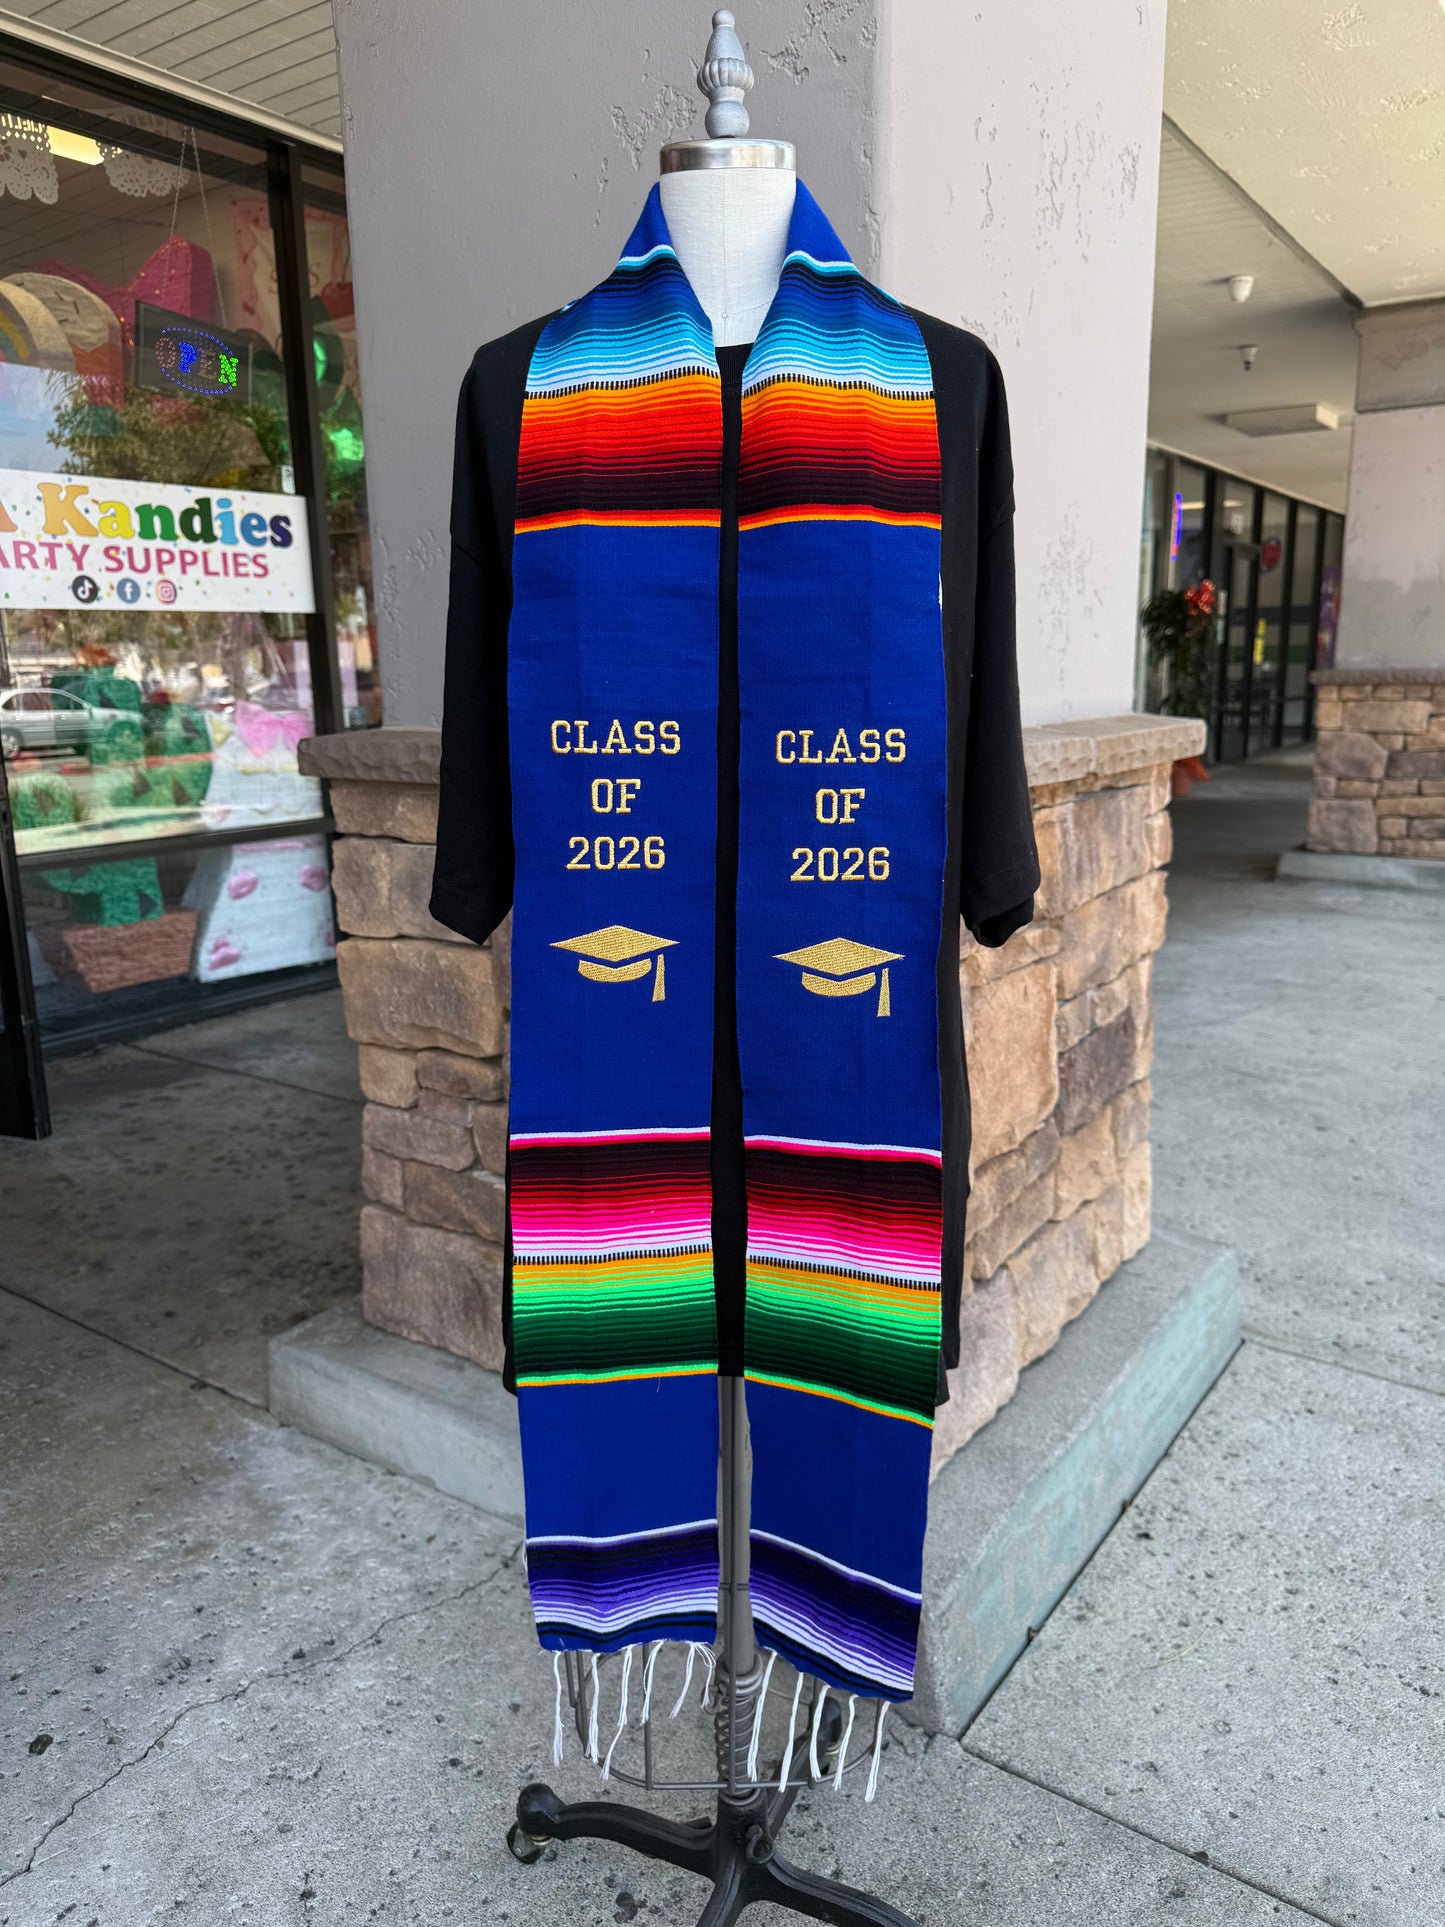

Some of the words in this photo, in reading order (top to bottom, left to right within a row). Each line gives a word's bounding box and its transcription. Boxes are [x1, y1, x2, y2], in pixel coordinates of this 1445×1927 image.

[155, 337, 238, 387] OPEN
[37, 482, 293, 548] Kandies
[104, 545, 269, 578] SUPPLIES
[551, 719, 681, 754] CLASS
[775, 728, 906, 764] CLASS
[591, 778, 641, 813] OF
[815, 788, 866, 824] OF
[566, 836, 666, 870] 2026
[790, 847, 890, 882] 2026
